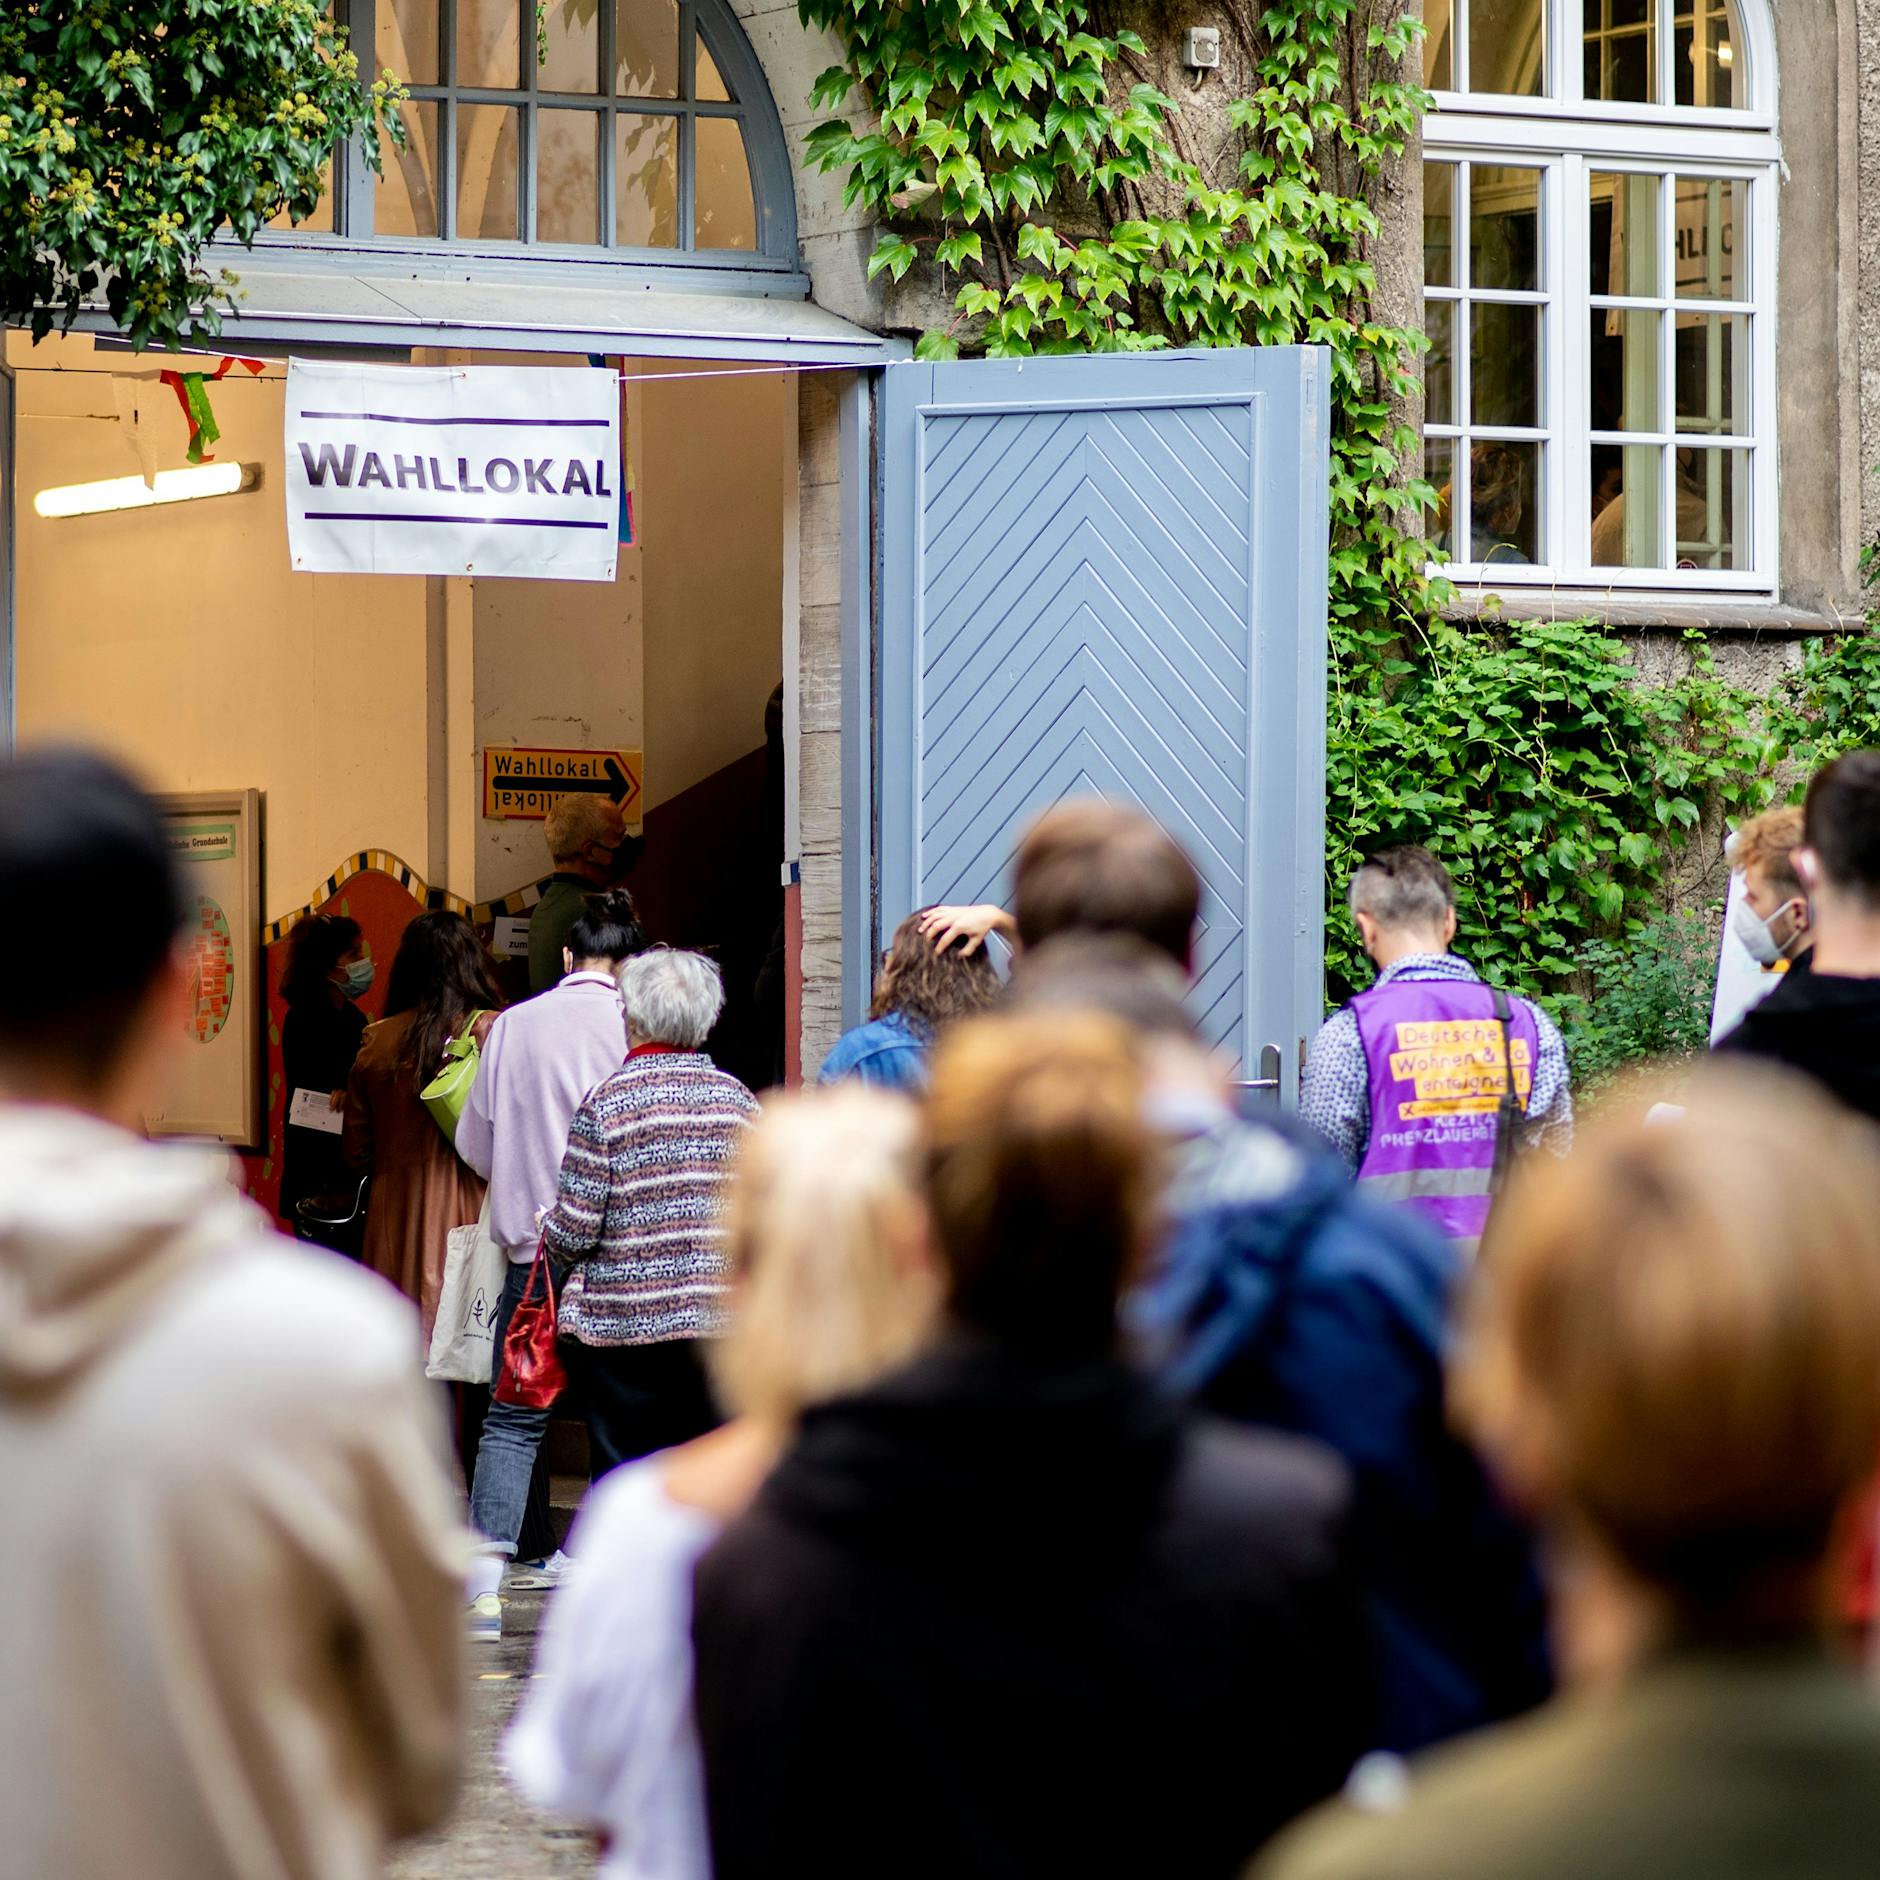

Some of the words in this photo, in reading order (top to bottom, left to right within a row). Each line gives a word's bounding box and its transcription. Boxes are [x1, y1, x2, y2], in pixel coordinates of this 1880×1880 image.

[297, 442, 613, 497] WAHLLOKAL
[494, 755, 599, 778] Wahllokal
[1404, 1026, 1498, 1044] Deutsche
[1396, 1052, 1476, 1073] Wohnen
[1422, 1071, 1525, 1096] enteigne!
